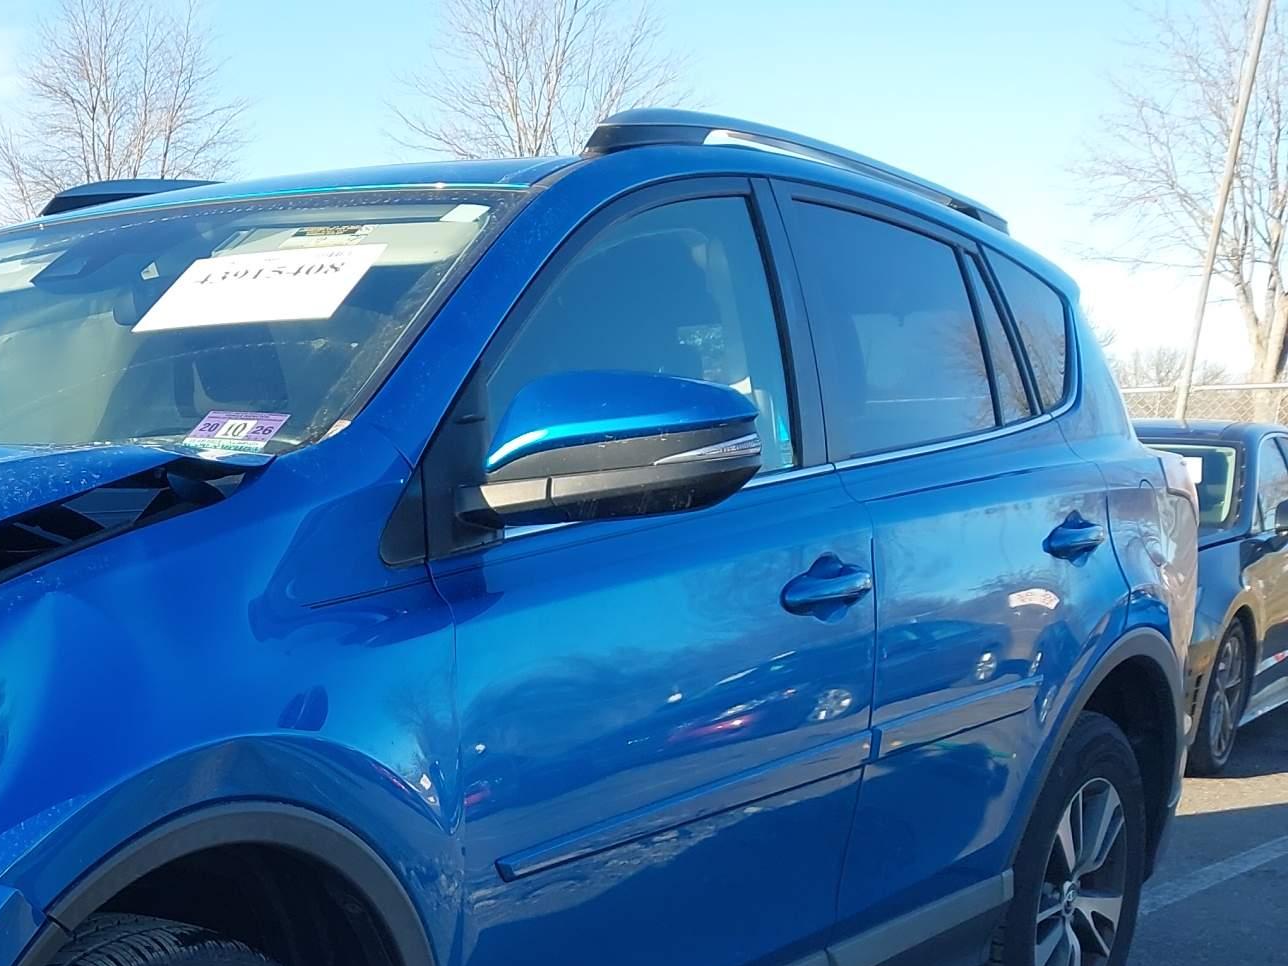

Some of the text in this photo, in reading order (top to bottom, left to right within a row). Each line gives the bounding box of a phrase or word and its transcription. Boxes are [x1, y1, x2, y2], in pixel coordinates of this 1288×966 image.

[199, 422, 274, 437] 20 10 26
